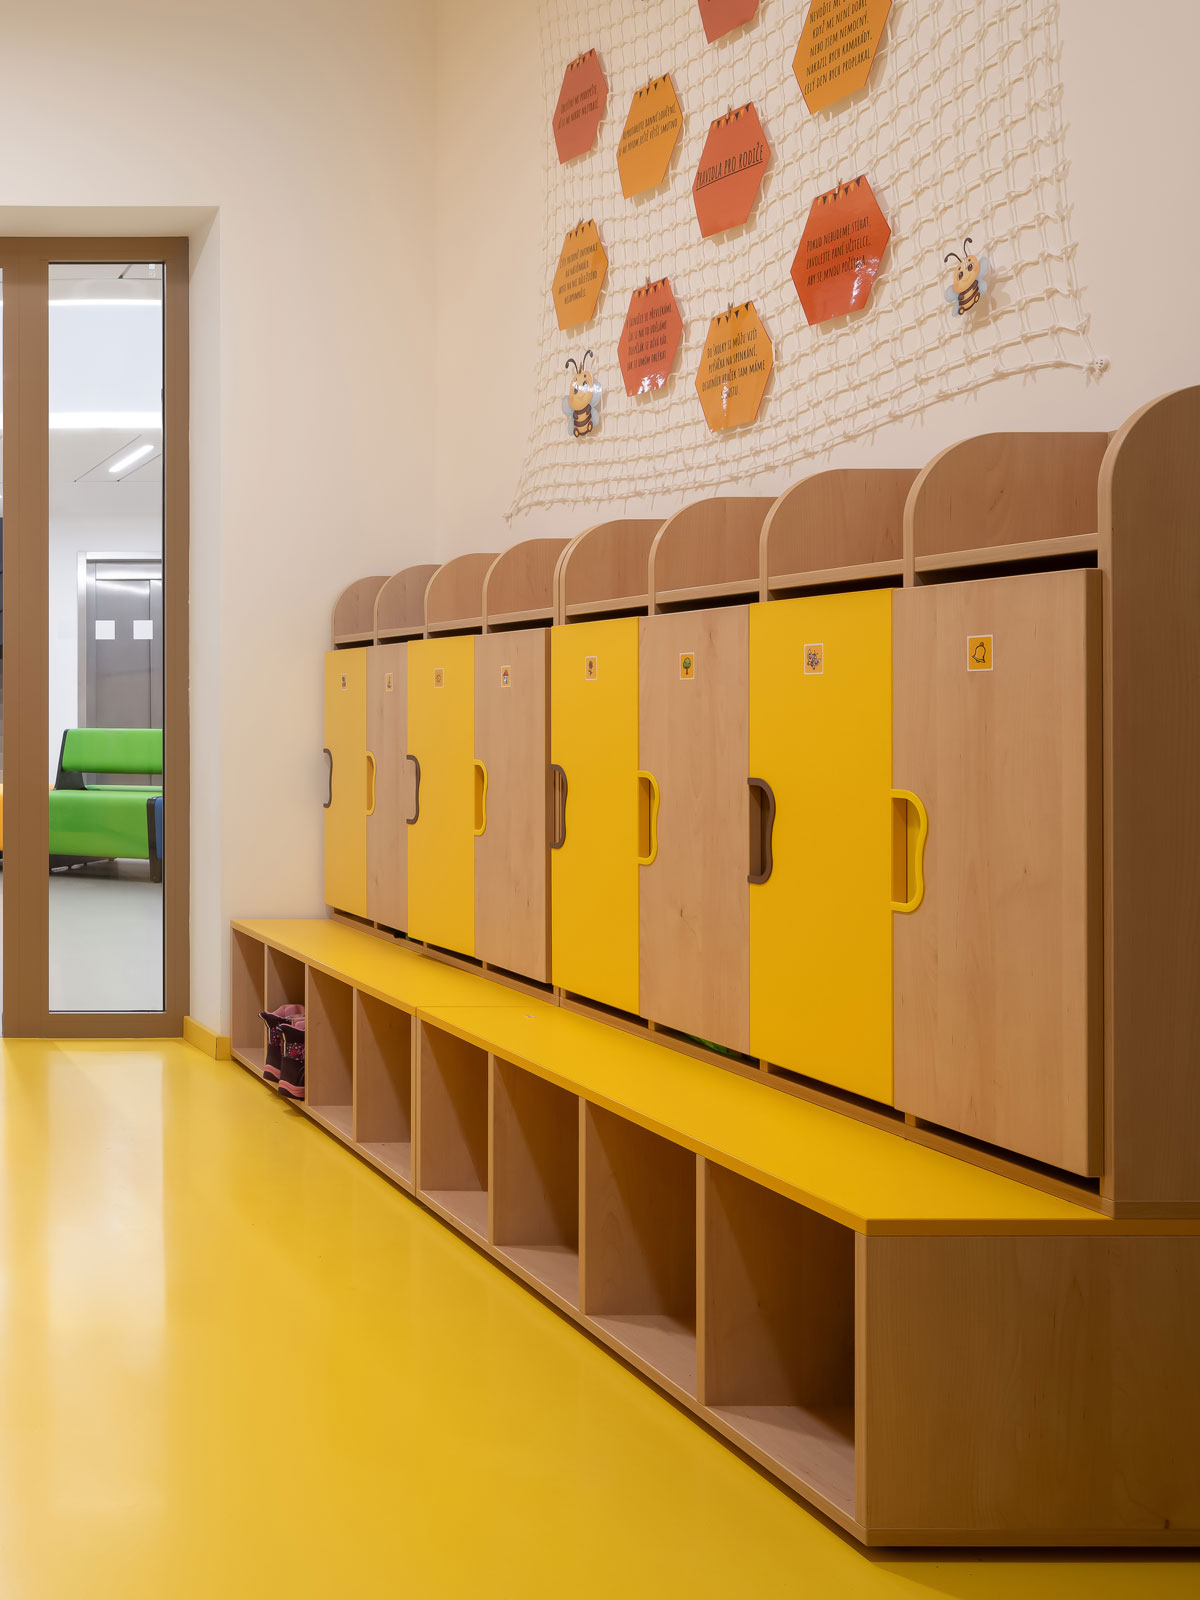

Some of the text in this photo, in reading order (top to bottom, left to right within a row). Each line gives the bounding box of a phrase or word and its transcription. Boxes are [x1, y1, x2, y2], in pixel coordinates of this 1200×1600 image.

[813, 22, 825, 39] KDYŽ
[836, 4, 850, 24] NENÍ
[810, 41, 824, 58] NEBO
[816, 73, 827, 88] DEN
[696, 141, 763, 189] PRAVIDLA PRO RODIČE
[806, 236, 822, 252] POKUD
[824, 223, 850, 246] NEBUDEME
[806, 250, 830, 270] ZAVOLEJTE
[823, 263, 840, 281] MNOU
